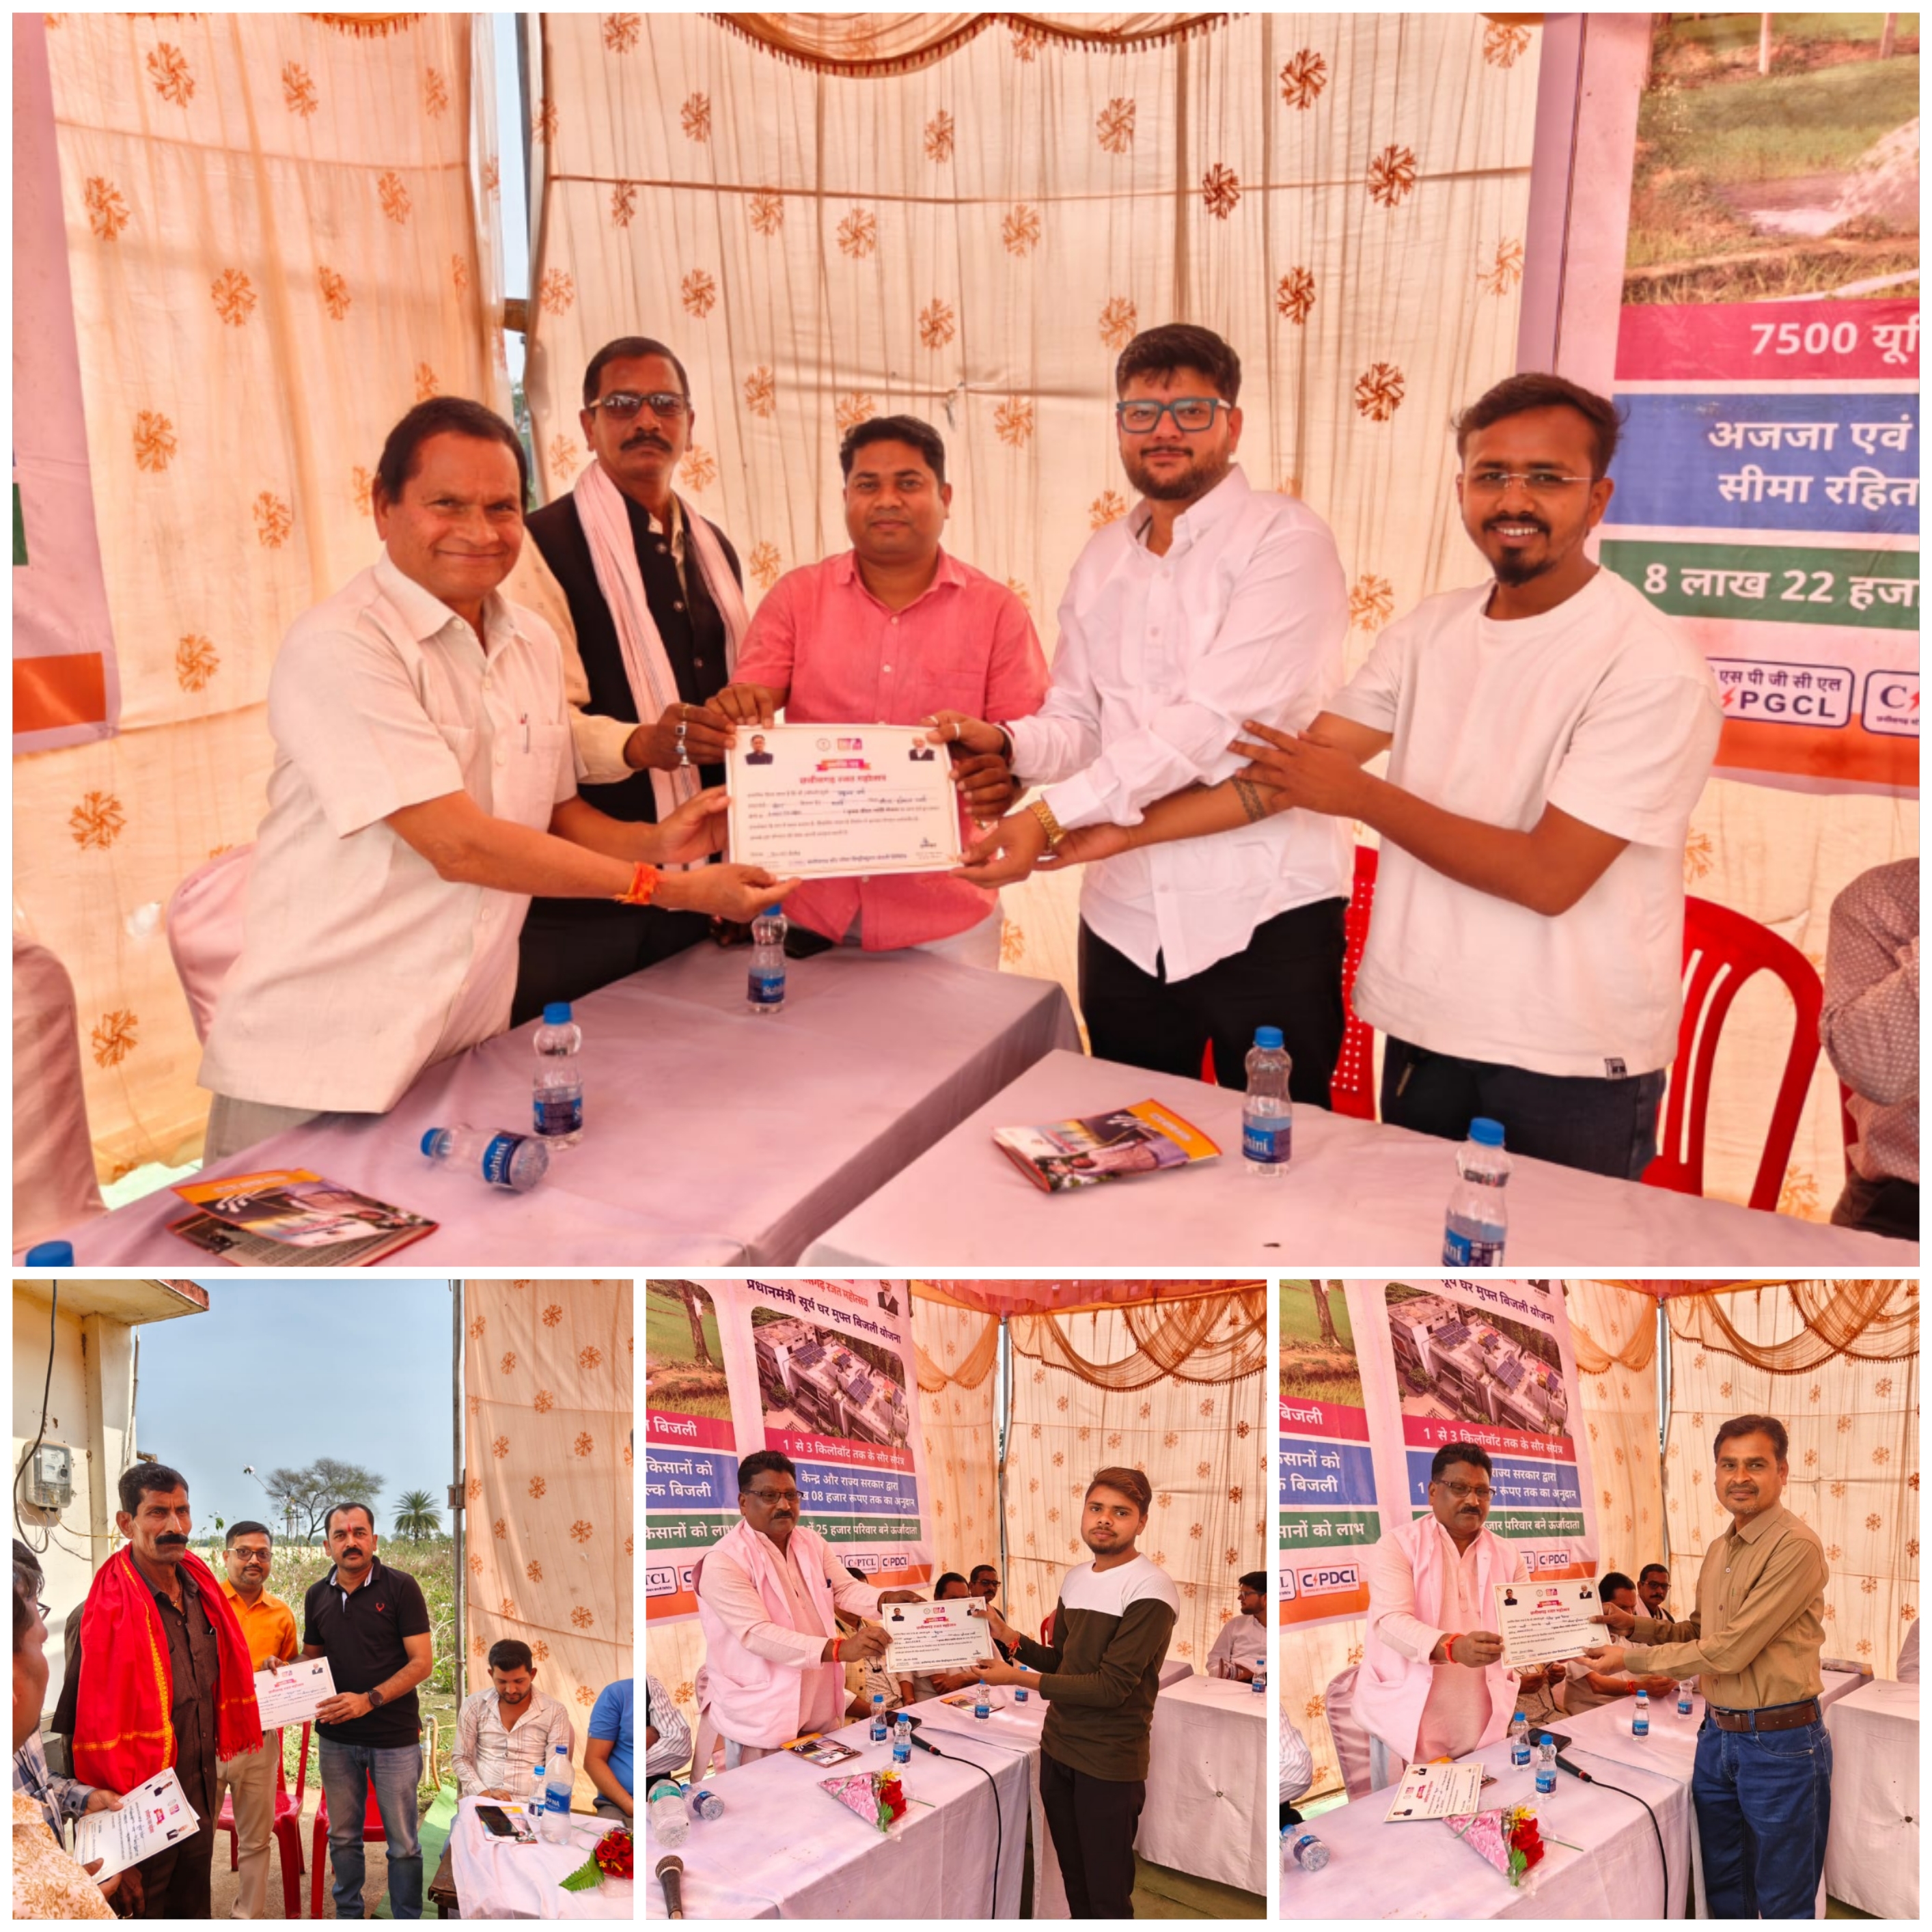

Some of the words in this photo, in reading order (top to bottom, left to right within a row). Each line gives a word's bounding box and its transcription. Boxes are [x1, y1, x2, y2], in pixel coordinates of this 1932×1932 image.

[1750, 321, 1858, 355] 7500
[1708, 422, 1839, 451] अजजा
[1850, 413, 1913, 455] एवं
[1717, 464, 1814, 503] सीमा
[1825, 466, 1919, 511] रहित
[1644, 563, 1668, 594] 8
[1680, 568, 1771, 599] लाख
[1780, 569, 1835, 603] 22
[1848, 576, 1919, 610] हज
[1719, 668, 1743, 684] एस
[1748, 667, 1764, 685] पी
[1768, 670, 1788, 687] जी
[1792, 672, 1812, 689] सी
[1817, 676, 1843, 693] एल
[746, 1280, 796, 1304] प्रधानमंत्री
[798, 1295, 815, 1312] सूर्य
[817, 1303, 830, 1316] घर
[831, 1308, 851, 1324] मुफ्त
[853, 1313, 879, 1335] बिजली
[879, 1325, 901, 1344] योजना
[1459, 1280, 1474, 1293] घर
[1476, 1285, 1498, 1302] मुफ्त
[1499, 1291, 1528, 1314] बिजली
[1530, 1304, 1555, 1325] योजना
[654, 1416, 698, 1437] बिजली
[1424, 1428, 1431, 1439] 1
[1437, 1426, 1448, 1441] से
[1450, 1431, 1458, 1442] 3
[1460, 1429, 1502, 1447] किलोवॉट
[1503, 1437, 1519, 1449] तक
[1520, 1437, 1530, 1451] के
[1530, 1439, 1545, 1452] सौर
[783, 1439, 789, 1450] 1
[795, 1438, 804, 1452] से
[806, 1443, 813, 1453] 3
[814, 1441, 851, 1458] किलोवॉट
[853, 1449, 866, 1459] तक
[867, 1449, 875, 1461] के
[876, 1450, 889, 1462] सौर
[1321, 1451, 1340, 1469] को
[695, 1460, 713, 1476] को
[1513, 1469, 1541, 1481] सरकार
[1541, 1471, 1557, 1483] द्वारा
[670, 1480, 712, 1498] बिजली
[801, 1470, 820, 1484] केन्द्र
[823, 1472, 839, 1485] और
[841, 1476, 859, 1487] राज्य
[860, 1479, 885, 1489] सरकार
[885, 1480, 899, 1491] द्वारा
[1291, 1473, 1338, 1493] बिजली
[811, 1491, 823, 1501] 08
[826, 1492, 847, 1504] हजार
[848, 1495, 868, 1505] रूपए
[869, 1495, 882, 1506] तक
[883, 1496, 894, 1506] का
[894, 1498, 915, 1509] अनुदान
[1418, 1482, 1425, 1494] 1
[1500, 1485, 1522, 1498] रूपए
[1523, 1486, 1538, 1497] तक
[1539, 1487, 1551, 1498] का
[1552, 1489, 1577, 1502] अनुदान
[690, 1521, 708, 1537] को
[817, 1524, 828, 1535] 25
[830, 1526, 851, 1536] हजार
[853, 1522, 877, 1535] परिवार
[879, 1524, 889, 1535] बने
[890, 1522, 917, 1535] ऊर्जादाता
[1312, 1519, 1332, 1538] को
[1336, 1522, 1365, 1536] लाभ
[1483, 1519, 1503, 1531] जार
[1504, 1517, 1533, 1530] परिवार
[1534, 1518, 1547, 1530] बने
[1548, 1517, 1580, 1530] ऊर्जादाता
